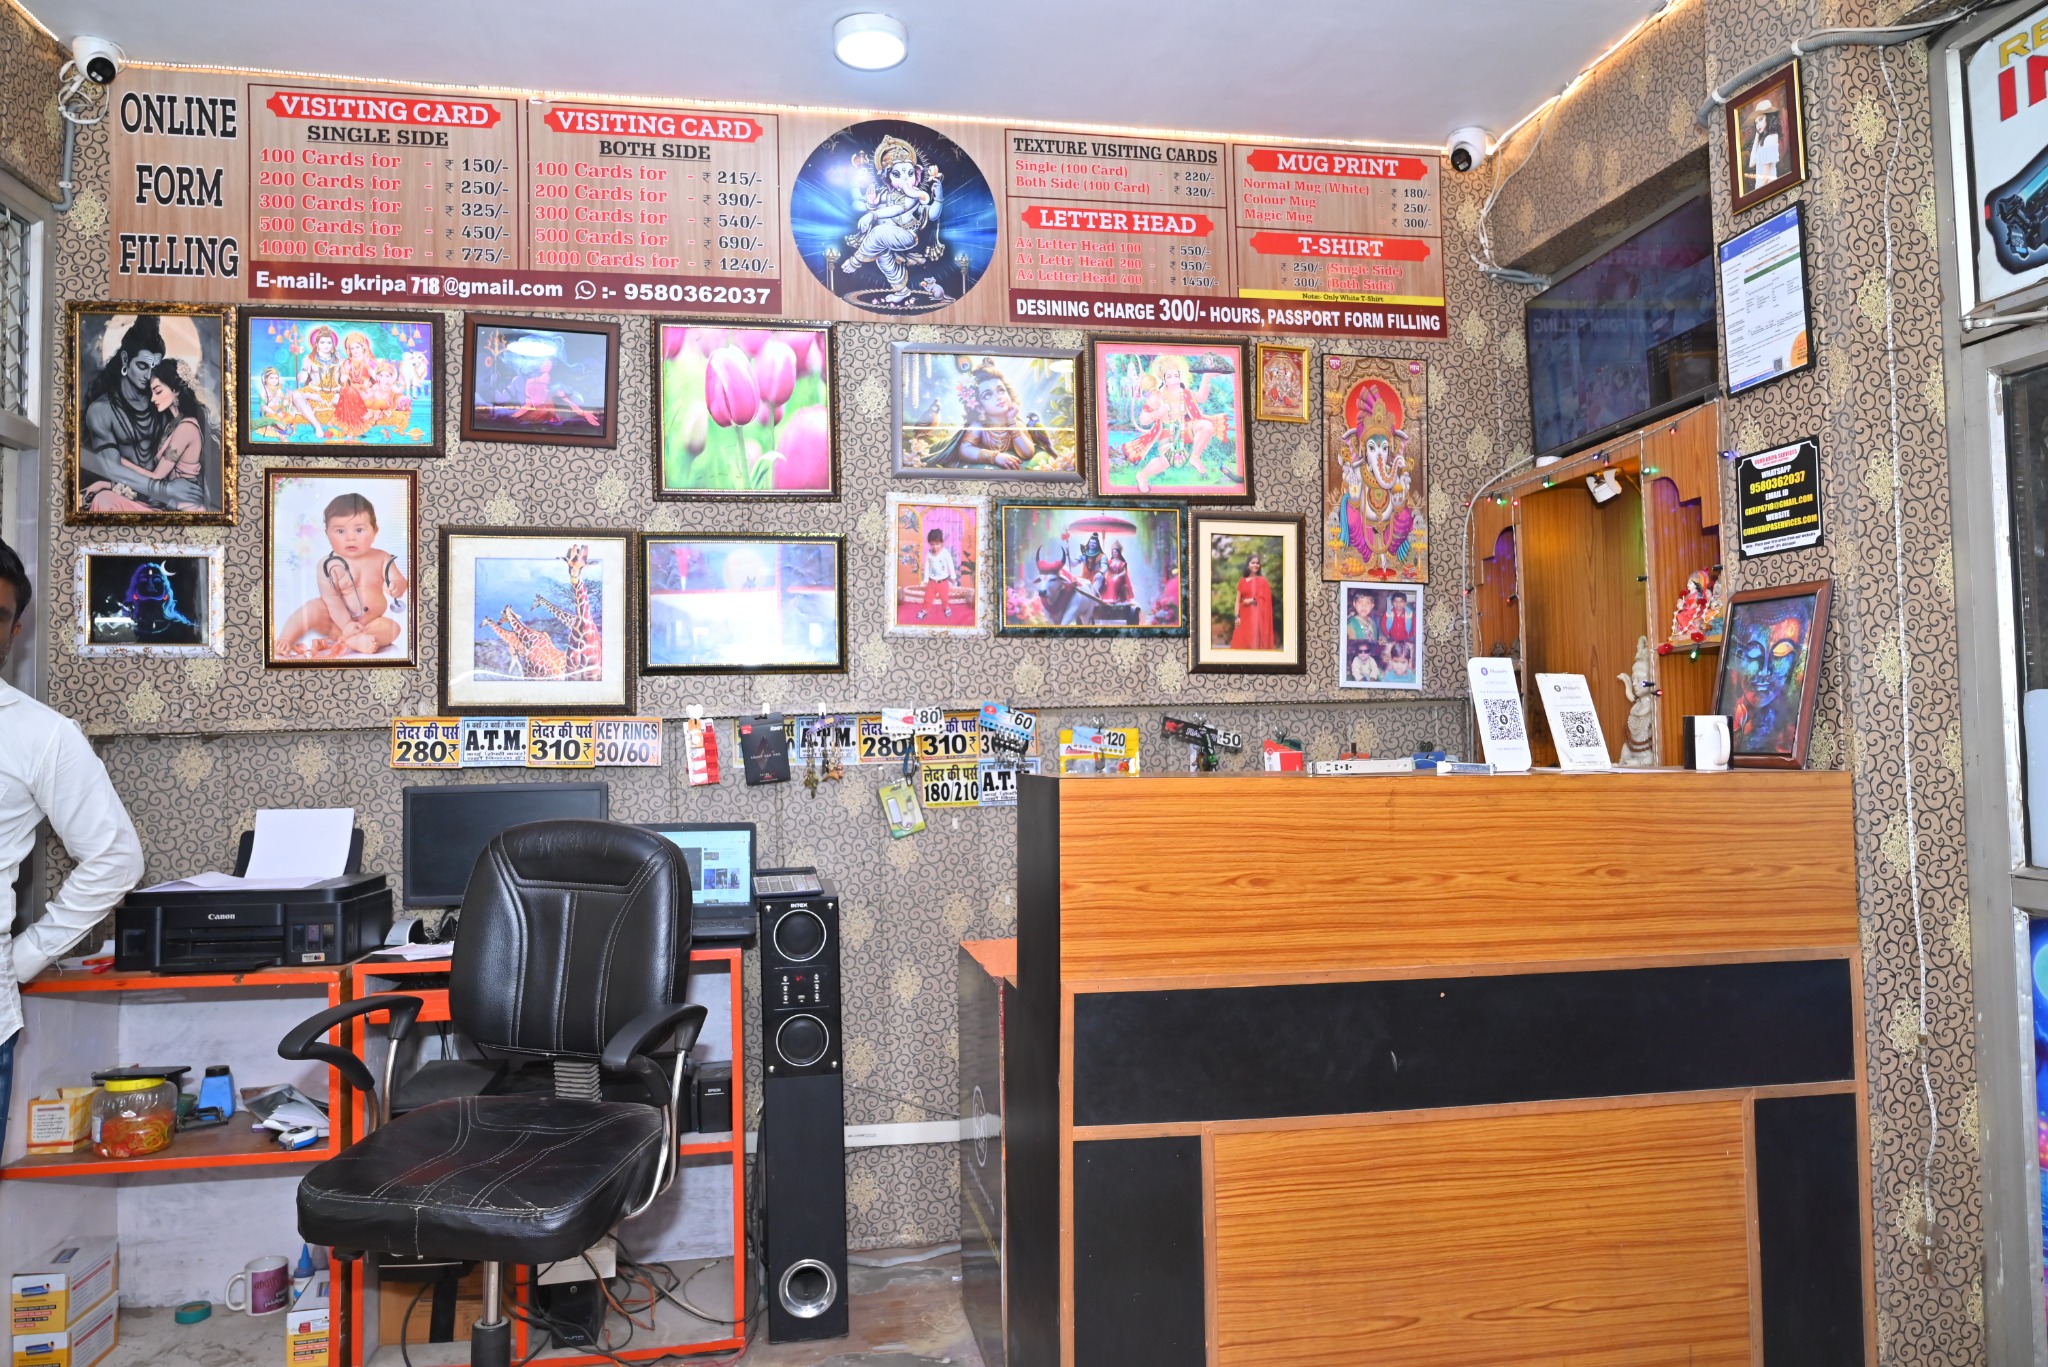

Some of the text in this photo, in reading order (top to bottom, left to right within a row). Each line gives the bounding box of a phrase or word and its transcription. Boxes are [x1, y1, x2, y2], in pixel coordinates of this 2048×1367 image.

[120, 92, 237, 138] ONLINE
[280, 95, 488, 125] VISITING CARD
[556, 111, 752, 139] VISITING CARD
[308, 126, 448, 146] SINGLE SIDE
[260, 148, 508, 174] 100 Cards for 150/-
[599, 141, 710, 160] BOTH SIDE
[1014, 138, 1218, 163] TEXTURE VISITING CARDS
[536, 162, 762, 187] 100 Cards for 215/-
[1016, 160, 1057, 173] Single
[1092, 165, 1128, 178] Card)
[1277, 154, 1398, 176] MUG PRINT
[136, 164, 223, 207] FORM
[260, 171, 509, 196] 200 Cards for 250/-
[1016, 176, 1046, 188] Both
[1051, 178, 1080, 190] Side
[1114, 182, 1150, 194] Card)
[1243, 178, 1290, 190] Normal
[1295, 180, 1321, 194] Mug
[1325, 182, 1369, 196] (White)
[260, 194, 509, 219] 300 Cards for 325/-
[535, 184, 763, 208] 200 Cards for 390/-
[1243, 193, 1285, 205] Colour
[1290, 196, 1317, 208] Mug
[535, 206, 763, 229] 300 Cards for 540/-
[1040, 209, 1196, 234] LETTER HEAD
[1244, 208, 1282, 222] Magic
[1286, 211, 1313, 224] Mug
[260, 217, 509, 242] 500 Cards for 450/-
[535, 229, 763, 251] 500 Cards for 690/-
[120, 234, 238, 278] FILLING
[260, 240, 510, 264] 1000 Cards for 775/-
[1016, 238, 1033, 248] A4
[1037, 238, 1077, 250] Letter
[1081, 241, 1115, 252] Head
[1120, 244, 1141, 254] 100
[1298, 237, 1383, 257] T-SHIRT
[536, 251, 775, 273] 1000 Cards for 1240/-
[1016, 253, 1032, 265] A4
[1080, 257, 1114, 268] Head
[1119, 259, 1142, 269] 200
[1016, 269, 1034, 280] A4
[1038, 270, 1078, 283] Letter
[1082, 273, 1116, 284] Head
[1120, 275, 1142, 285] 400
[624, 283, 770, 304] 9580362037
[1323, 294, 1338, 302] Only
[1017, 299, 1440, 330] DESINING CHARGE 300/- HOURS, PASSPORT FORM FILLING
[1750, 471, 1805, 494] 9580362037
[1761, 465, 1792, 479] WHATSAPP
[1766, 510, 1790, 522] WEBSITE
[396, 723, 422, 739] लेदर
[423, 722, 439, 740] की
[532, 721, 556, 738] लेदर
[559, 721, 574, 738] की
[598, 722, 658, 739] KEY RINGS
[465, 730, 526, 751] A.T.M.
[948, 766, 961, 781] की
[924, 782, 978, 802] 180/210
